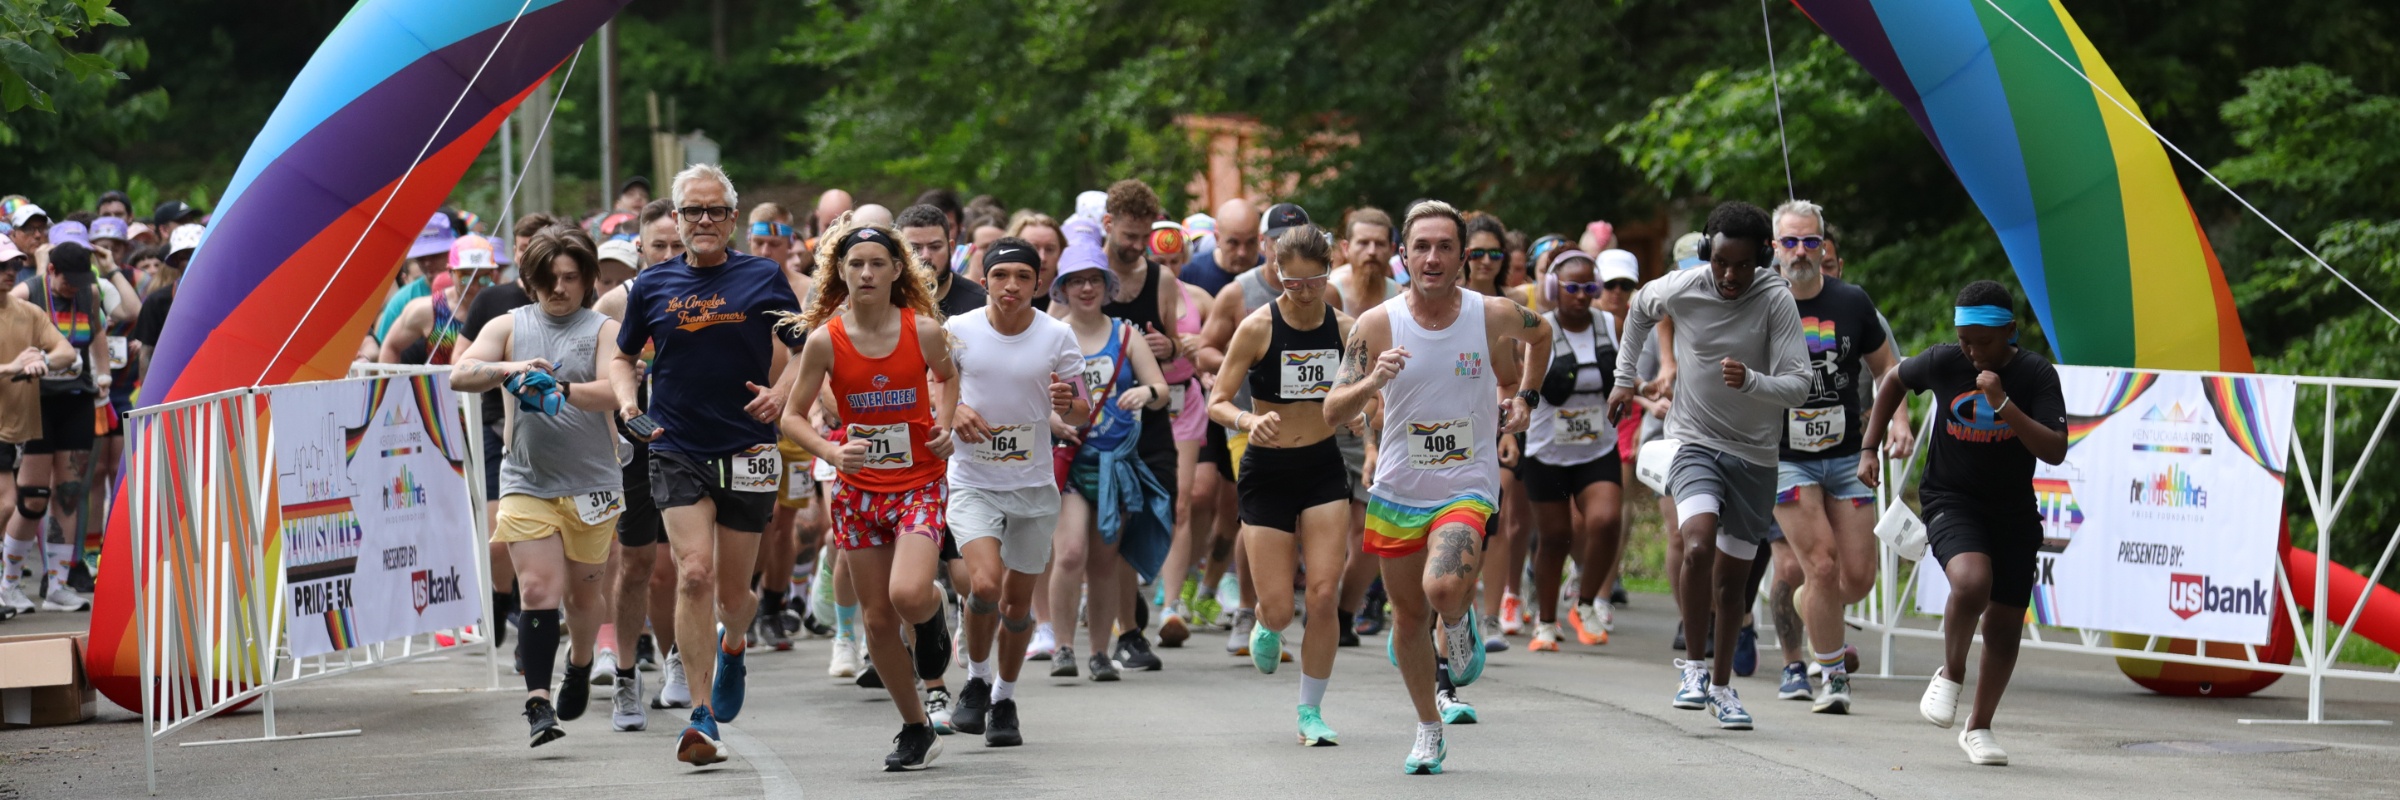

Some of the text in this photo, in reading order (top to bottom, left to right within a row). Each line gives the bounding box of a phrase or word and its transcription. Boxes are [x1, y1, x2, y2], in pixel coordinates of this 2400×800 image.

[665, 293, 727, 313] Los Angeles
[677, 309, 747, 326] Frontrunners
[1456, 358, 1481, 368] WITH
[1459, 352, 1479, 361] RUN
[1297, 365, 1324, 382] 378
[1455, 367, 1482, 376] PRIDE
[846, 387, 917, 408] SILVER CREEK
[1805, 420, 1831, 437] 657
[1946, 419, 2016, 443] CHAMPIO
[991, 436, 1017, 452] 164
[1424, 434, 1456, 453] 408
[2190, 431, 2213, 445] PRIDE
[747, 457, 775, 475] 583
[2130, 483, 2208, 509] LOUISVILLE
[2131, 510, 2205, 523] PRIDE FOUNDATION
[288, 511, 360, 568] LOUISVILLE
[382, 546, 408, 571] PRESENTED
[2117, 540, 2185, 568] PRESENTED BY:
[294, 578, 353, 617] PRIDE 5K
